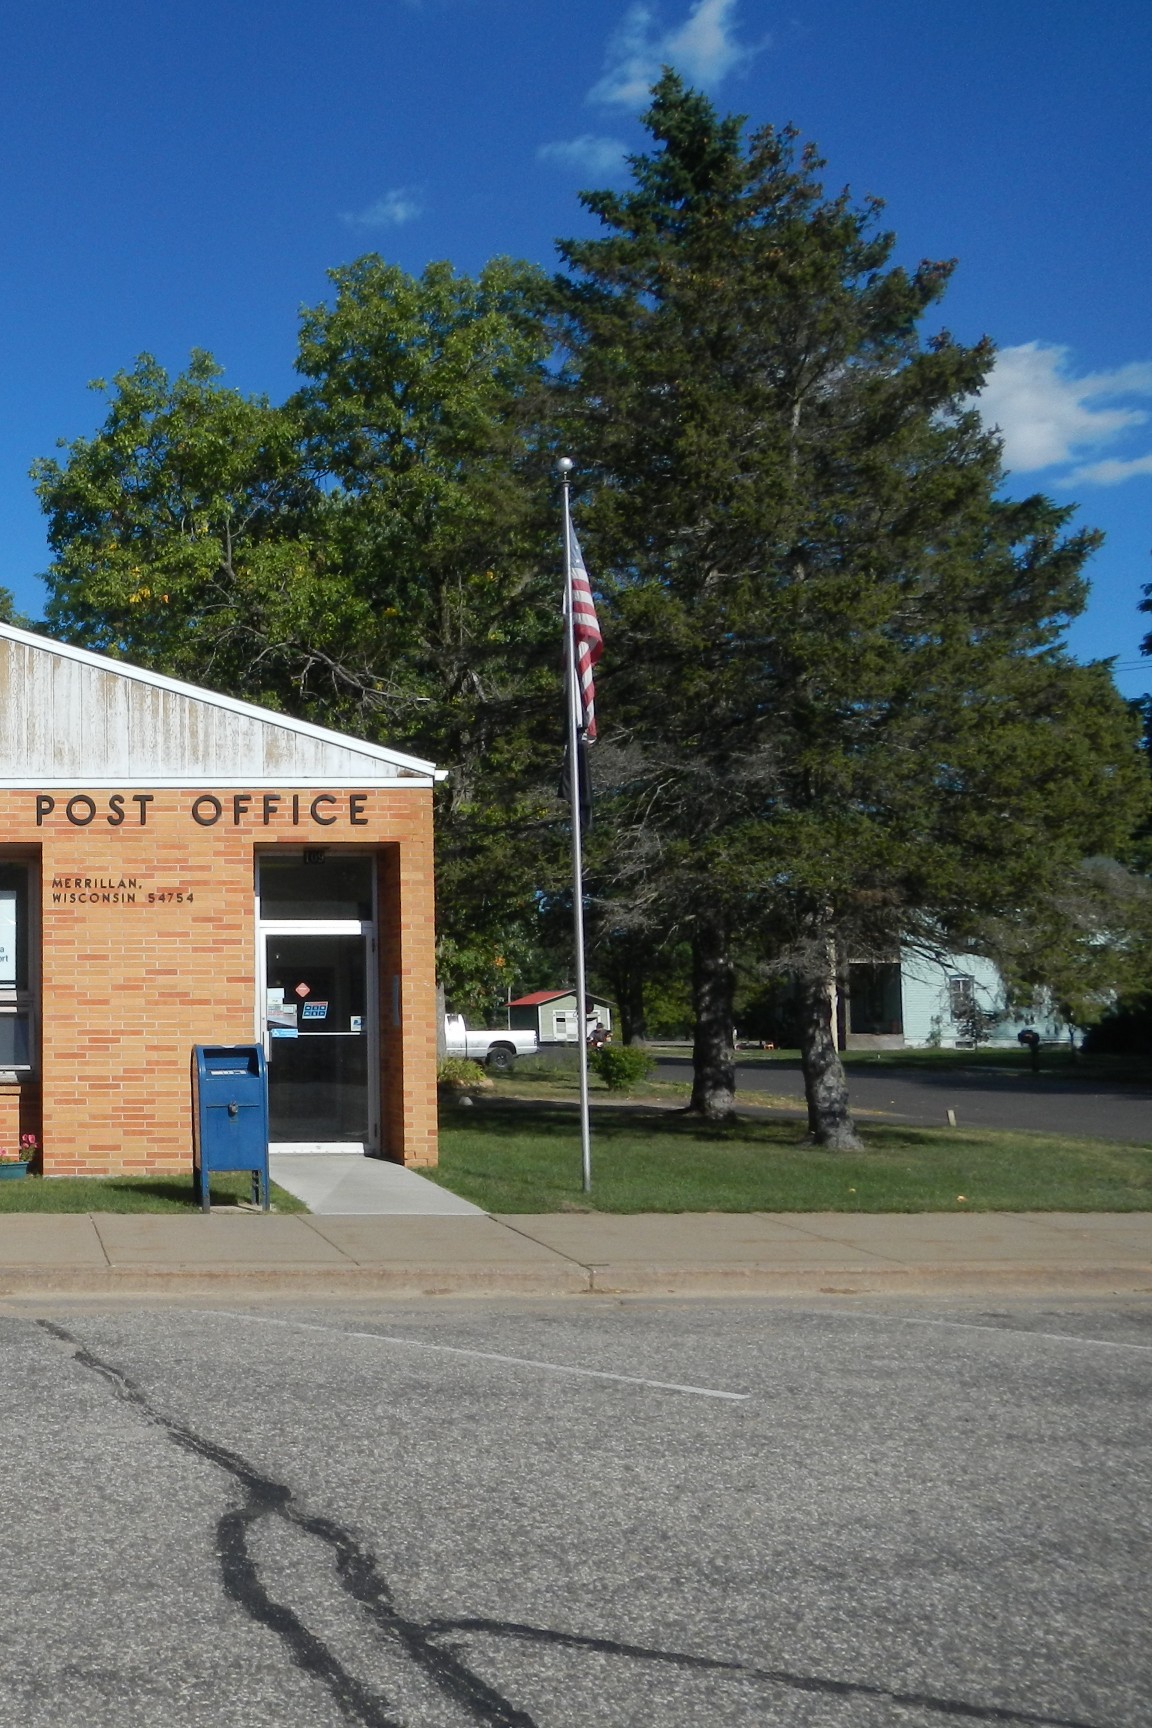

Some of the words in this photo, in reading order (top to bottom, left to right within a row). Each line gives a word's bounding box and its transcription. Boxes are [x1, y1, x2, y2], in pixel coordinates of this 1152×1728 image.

[35, 794, 154, 827] POST
[191, 794, 369, 827] OFFICE
[52, 878, 142, 890] MERRILLAN,
[52, 893, 136, 903] WISCONSIN
[148, 893, 194, 903] 54754
